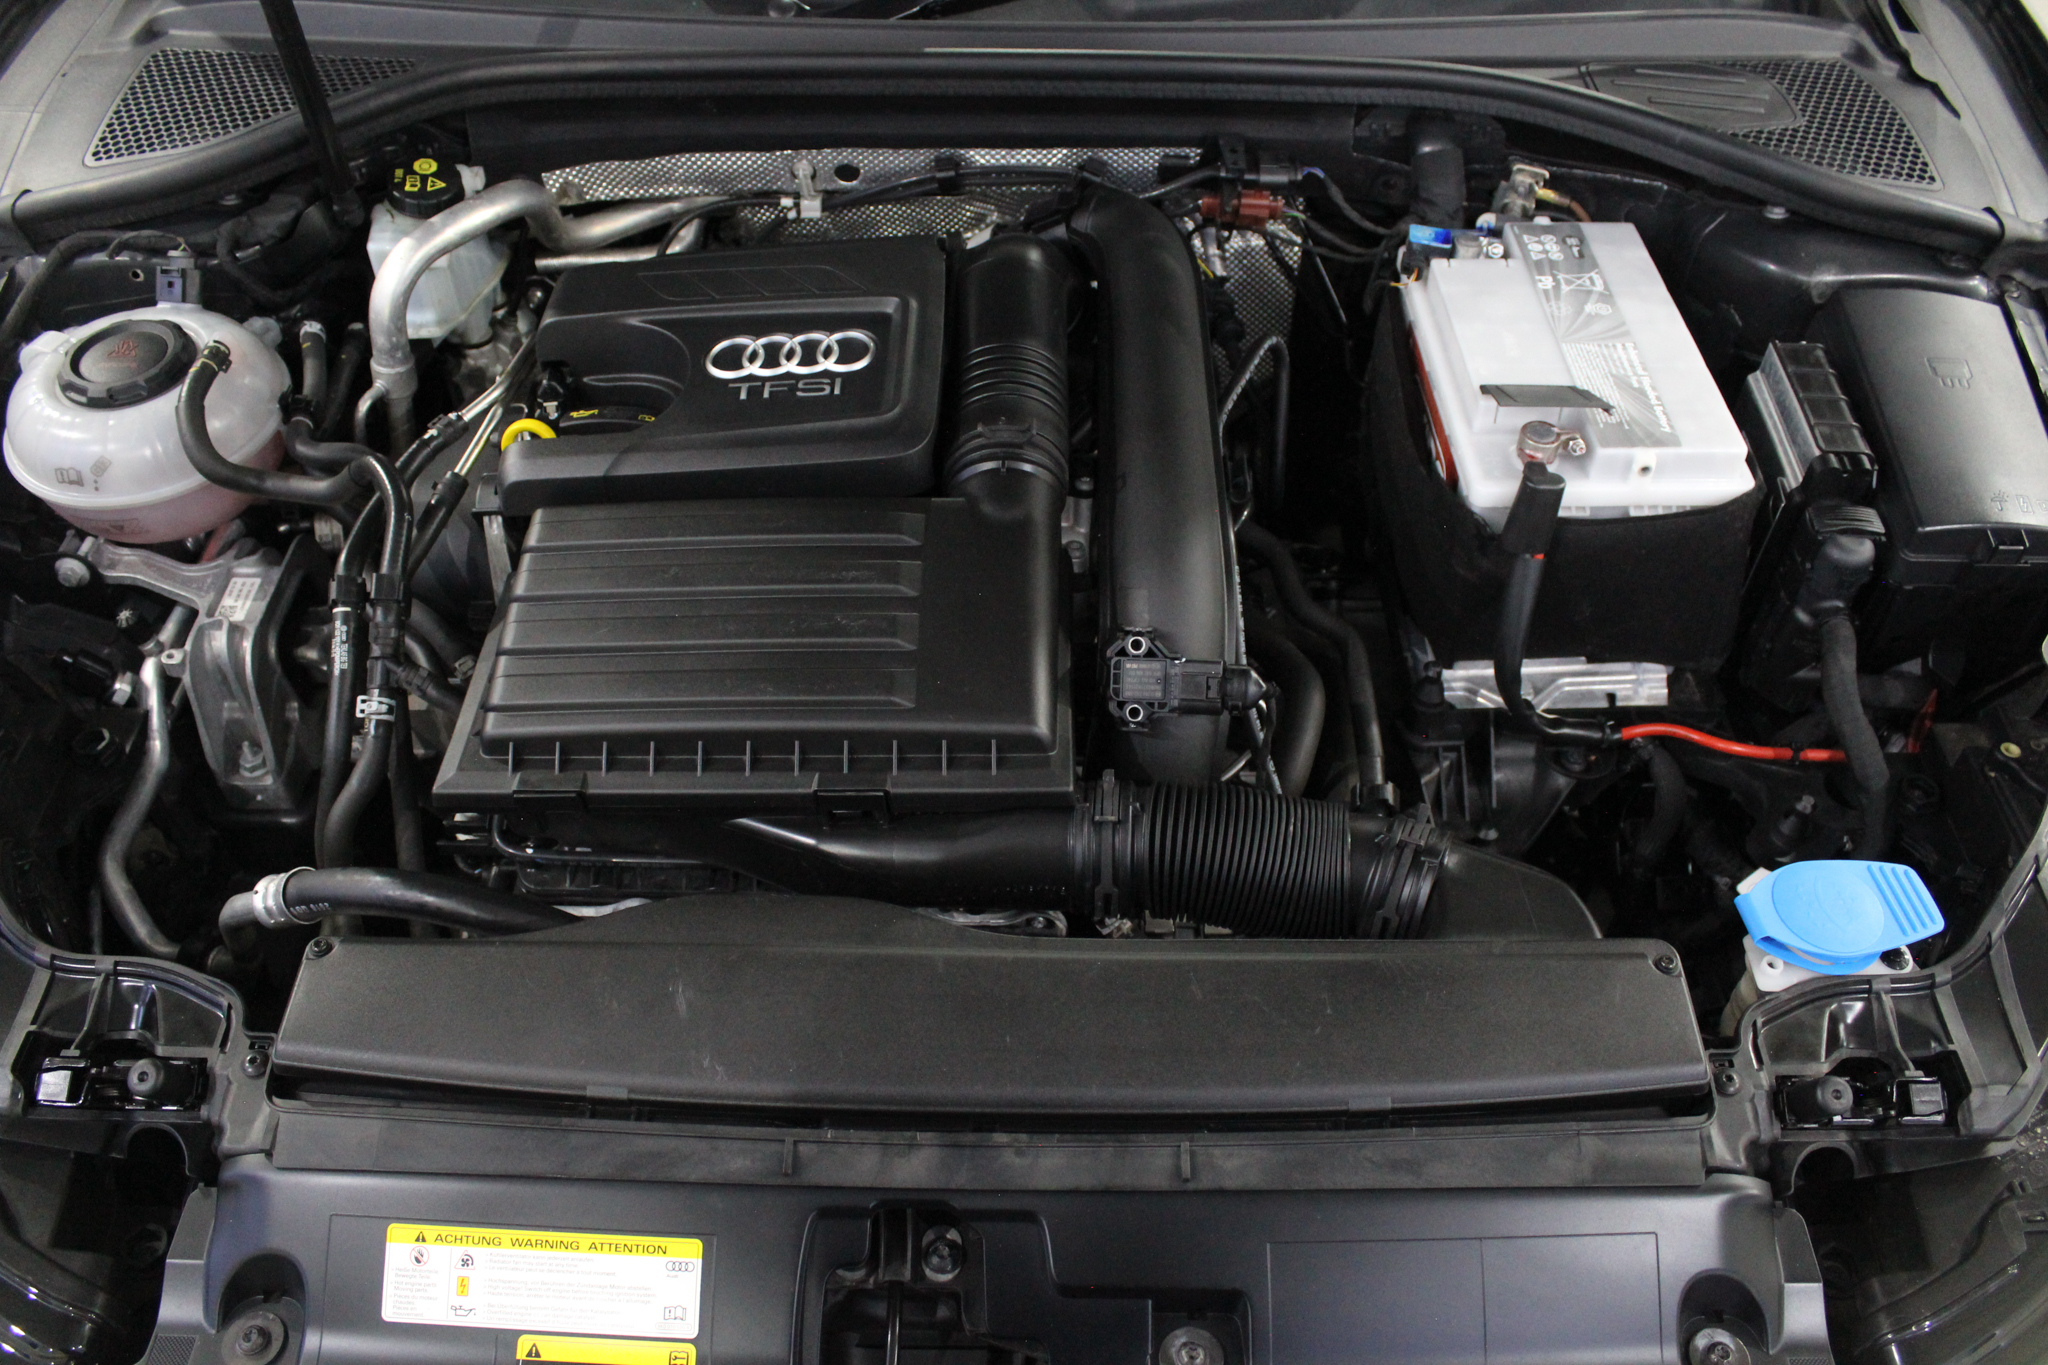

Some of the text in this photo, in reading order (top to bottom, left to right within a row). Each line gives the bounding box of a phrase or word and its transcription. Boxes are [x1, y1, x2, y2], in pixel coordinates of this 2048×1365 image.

[1535, 276, 1556, 289] Pb
[728, 377, 841, 400] TFSI
[1640, 375, 1662, 405] Flooded
[1653, 405, 1672, 433] Battery
[434, 1233, 667, 1254] ACHTUNG WARNING ATTENTION
